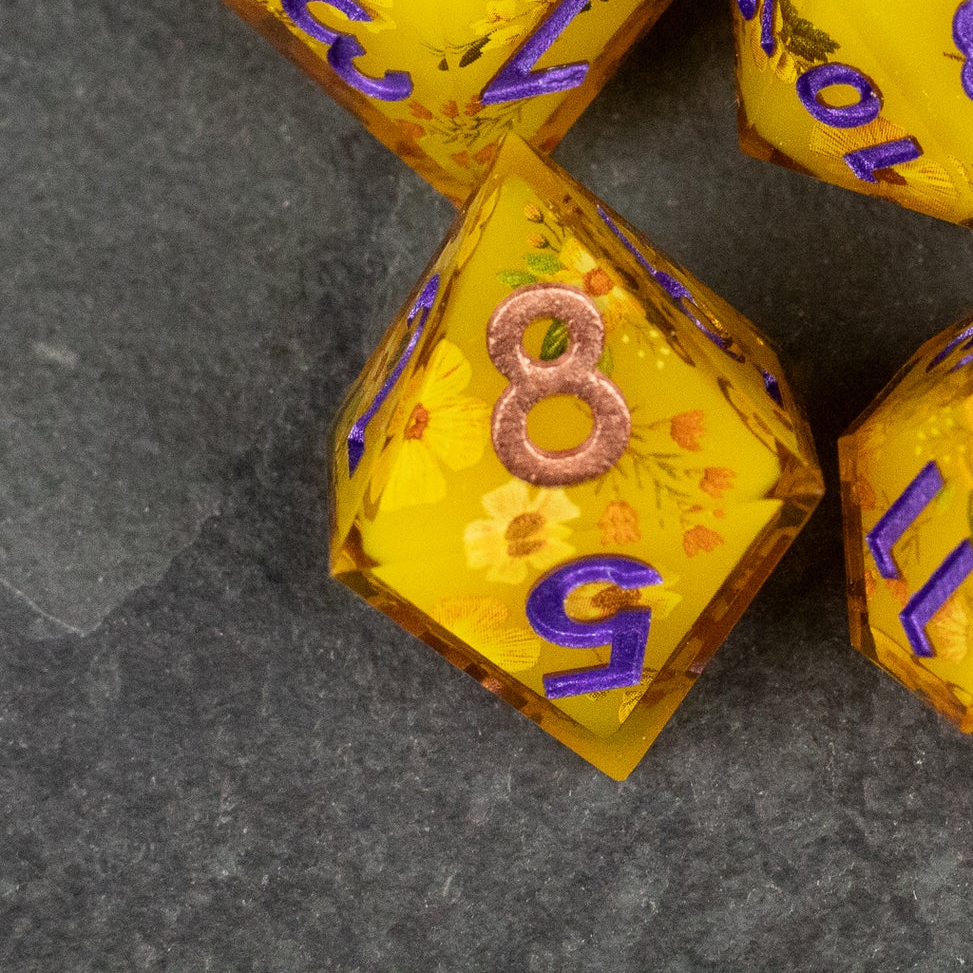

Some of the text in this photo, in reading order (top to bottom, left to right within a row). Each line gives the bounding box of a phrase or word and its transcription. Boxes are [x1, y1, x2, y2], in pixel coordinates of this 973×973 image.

[795, 63, 925, 185] 10
[486, 283, 632, 487] 8
[526, 554, 664, 700] 5
